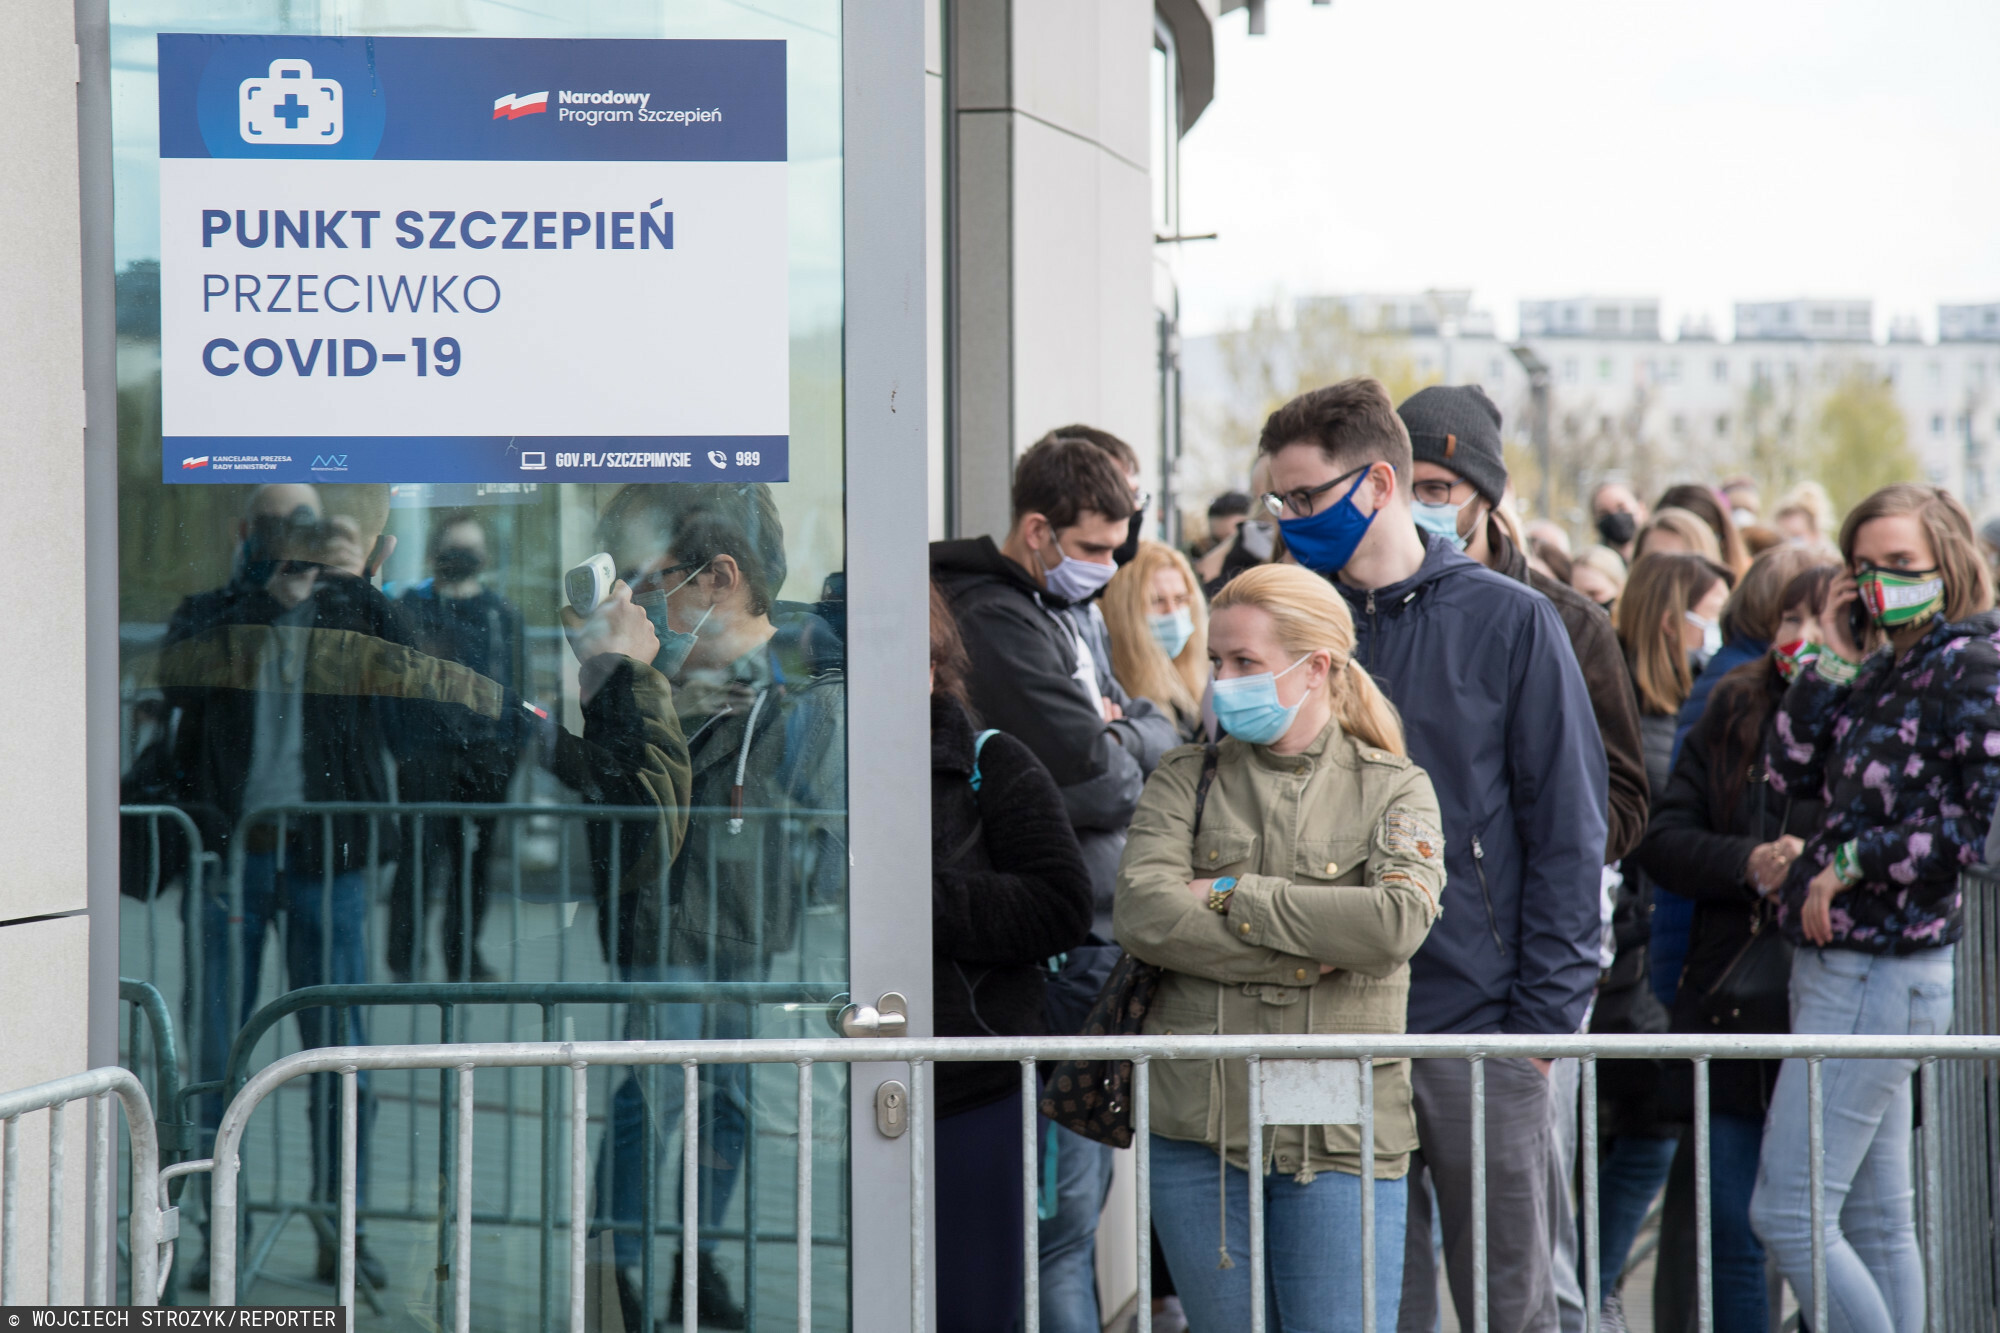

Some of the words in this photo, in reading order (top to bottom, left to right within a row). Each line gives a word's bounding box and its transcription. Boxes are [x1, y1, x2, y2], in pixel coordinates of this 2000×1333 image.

[558, 90, 651, 108] Narodowy
[559, 108, 634, 126] Program
[638, 107, 722, 127] Szczepień
[202, 209, 381, 249] PUNKT
[395, 197, 674, 250] SZCZEPIEŃ
[203, 273, 501, 313] PRZECIWKO
[202, 336, 462, 377] COVID-19
[555, 452, 692, 468] GOV.PL/SZCZEPIMYSIE
[735, 451, 761, 467] 989
